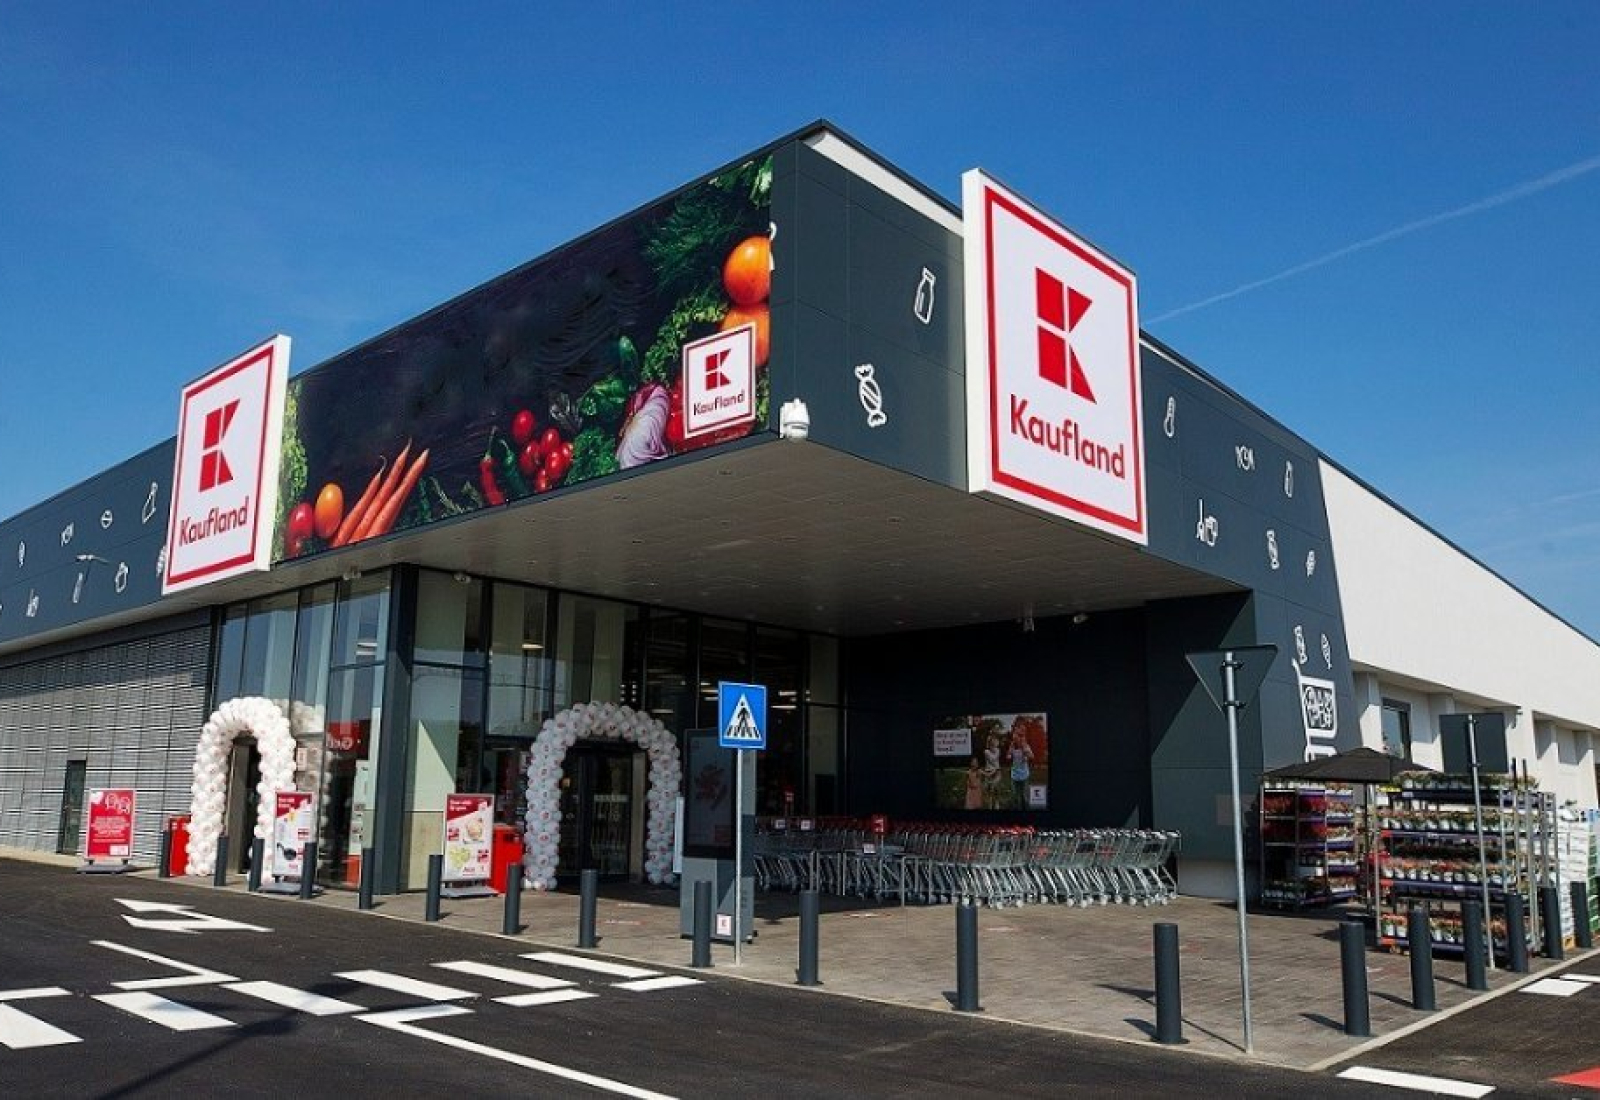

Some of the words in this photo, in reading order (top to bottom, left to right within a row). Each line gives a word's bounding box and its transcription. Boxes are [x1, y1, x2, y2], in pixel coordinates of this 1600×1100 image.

[1036, 267, 1097, 404] K
[693, 389, 745, 415] Kaufland
[706, 349, 731, 391] K
[199, 398, 240, 492] K
[1010, 393, 1126, 479] Kaufland
[179, 496, 250, 547] Kaufland
